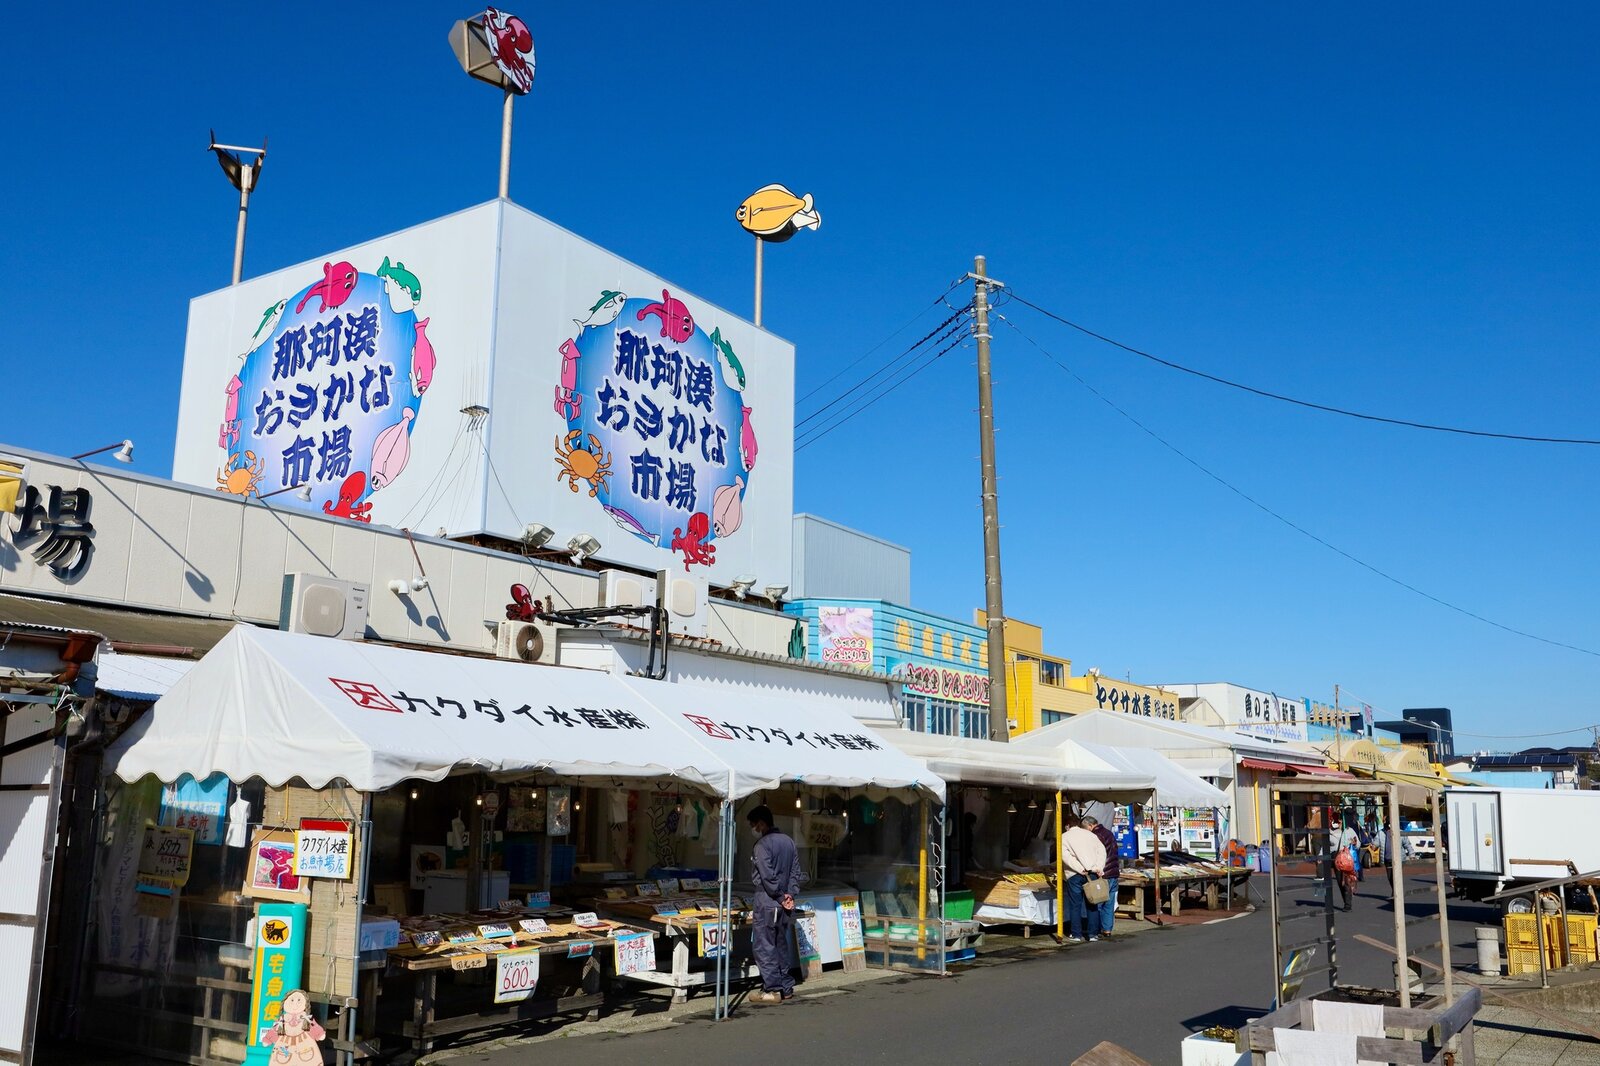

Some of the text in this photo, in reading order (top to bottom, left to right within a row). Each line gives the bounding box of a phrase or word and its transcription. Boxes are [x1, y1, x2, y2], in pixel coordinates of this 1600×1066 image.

[271, 308, 381, 383] 那珂湊
[614, 328, 716, 413] 那珂湊
[253, 362, 393, 437] おさかな
[596, 379, 727, 467] おさかな
[281, 424, 353, 489] 市場
[629, 452, 698, 513] 市場
[823, 650, 869, 661] どんぶり屋
[1096, 683, 1151, 717] ヤマサ水産
[300, 854, 344, 873] お魚市場店
[302, 837, 348, 854] カクダイ水産
[263, 953, 286, 1021] 宅急便
